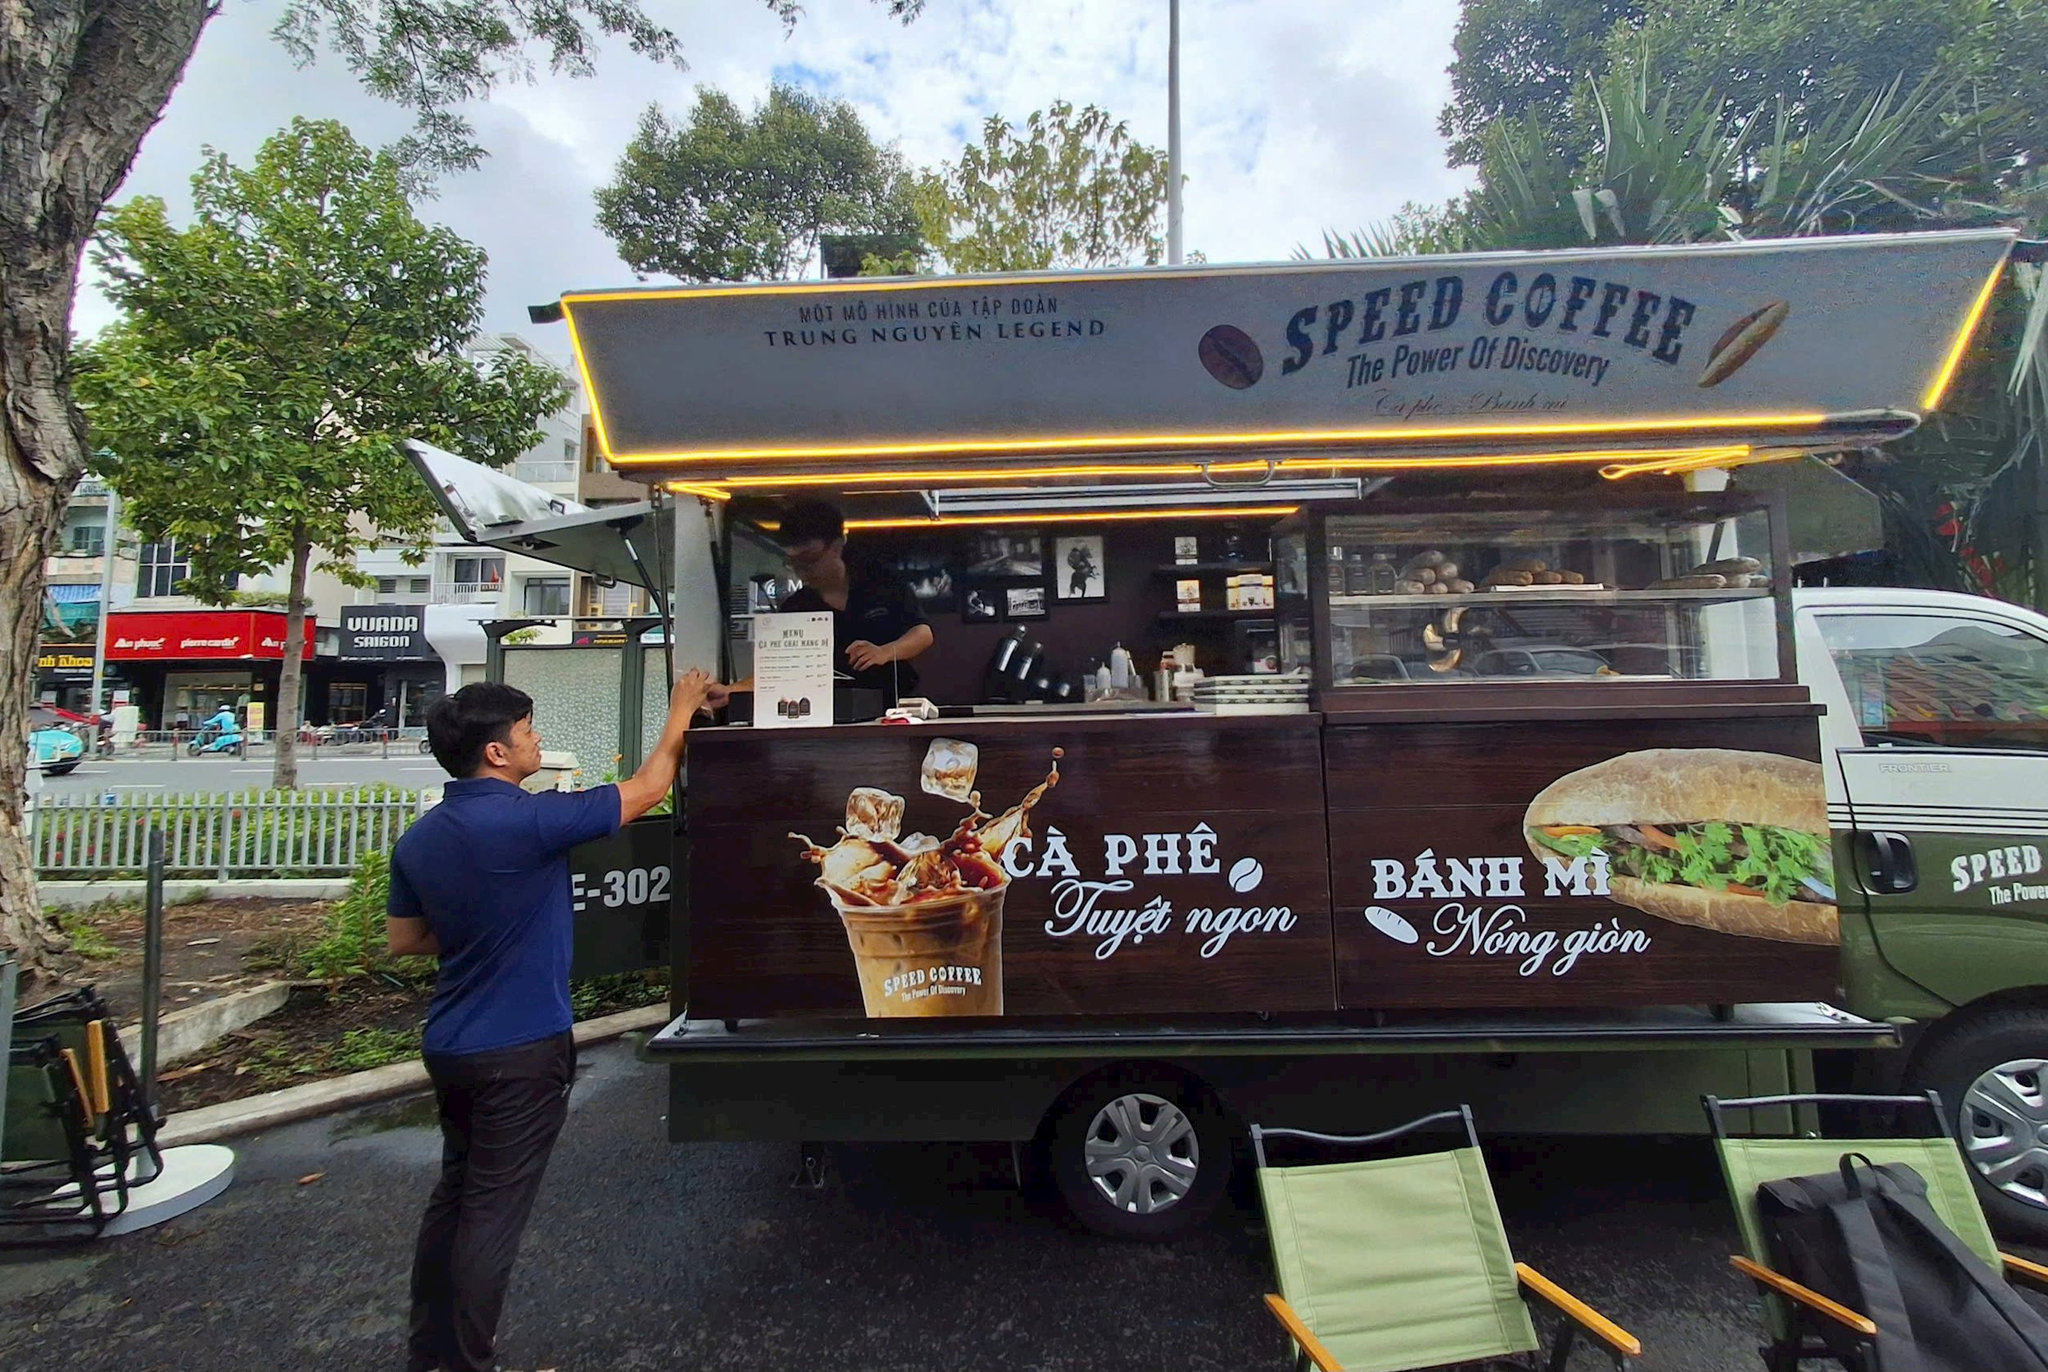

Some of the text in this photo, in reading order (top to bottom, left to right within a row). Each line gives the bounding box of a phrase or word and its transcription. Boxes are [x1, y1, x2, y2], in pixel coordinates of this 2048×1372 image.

[842, 300, 867, 321] MÔ
[972, 296, 1002, 319] TẬP
[1281, 271, 1696, 376] SPEED COFFEE
[764, 319, 1105, 347] TRUNG NGUYÊN LEGEND
[1346, 335, 1610, 388] The Power Of Discovery
[353, 635, 410, 648] SAIGON
[782, 628, 804, 639] MENU
[1879, 763, 1951, 774] FRONTIER
[1000, 821, 1220, 877] CÀ PHÊ
[1370, 846, 1613, 900] BÁNH MÌ
[1951, 845, 2042, 893] SPEED
[1989, 885, 2012, 905] The
[1044, 878, 1298, 960] Tuyệt ngon
[1426, 902, 1652, 976] Nóng giòn
[883, 966, 982, 997] SPEED COFFEE
[912, 988, 930, 999] Power
[938, 985, 966, 996] Discovery
